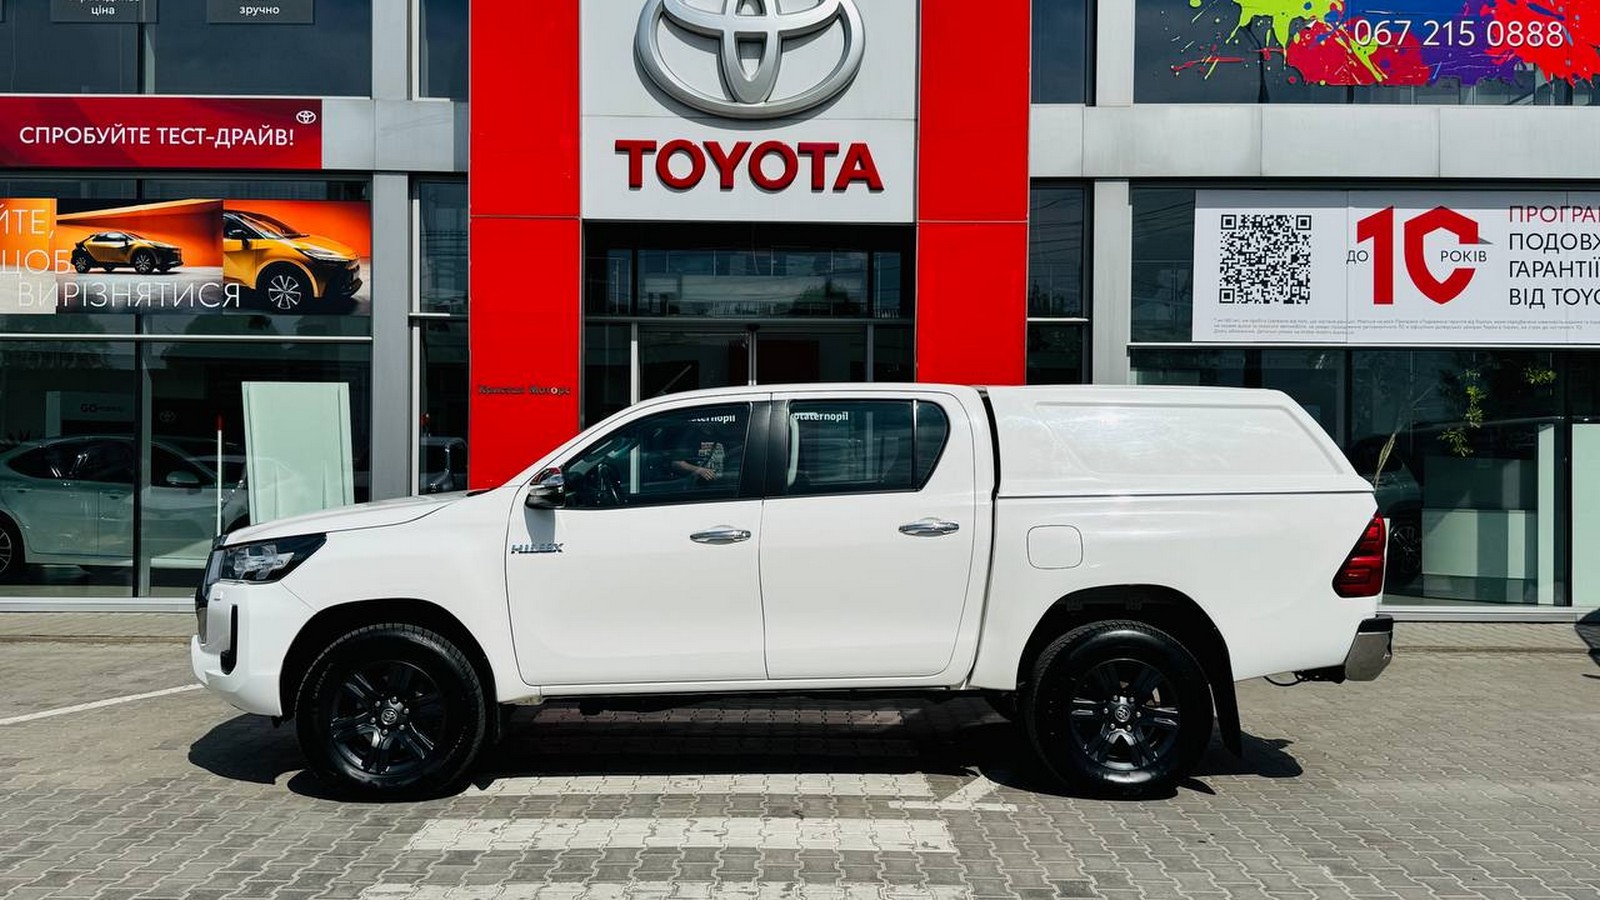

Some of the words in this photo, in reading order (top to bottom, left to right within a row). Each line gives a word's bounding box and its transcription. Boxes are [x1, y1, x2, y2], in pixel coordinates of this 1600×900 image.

[91, 5, 115, 16] ціна
[239, 6, 280, 16] зручно
[1354, 19, 1412, 46] 067
[1423, 20, 1476, 46] 215
[1487, 21, 1564, 47] 0888
[19, 123, 151, 145] СПРОБУЙТЕ
[156, 124, 295, 149] ТЕСТ-ДРАЙВ!
[614, 139, 885, 192] TOYOTA
[1509, 205, 1600, 222] ПРОГРА
[1345, 250, 1369, 265] ДО
[1440, 250, 1488, 263] РОКІВ
[1509, 256, 1600, 278] ГАРАНТІЇ
[18, 282, 240, 308] ВИРІЗНЯТИСЯ
[1509, 288, 1546, 309] ВІД
[511, 543, 564, 554] HILUX
